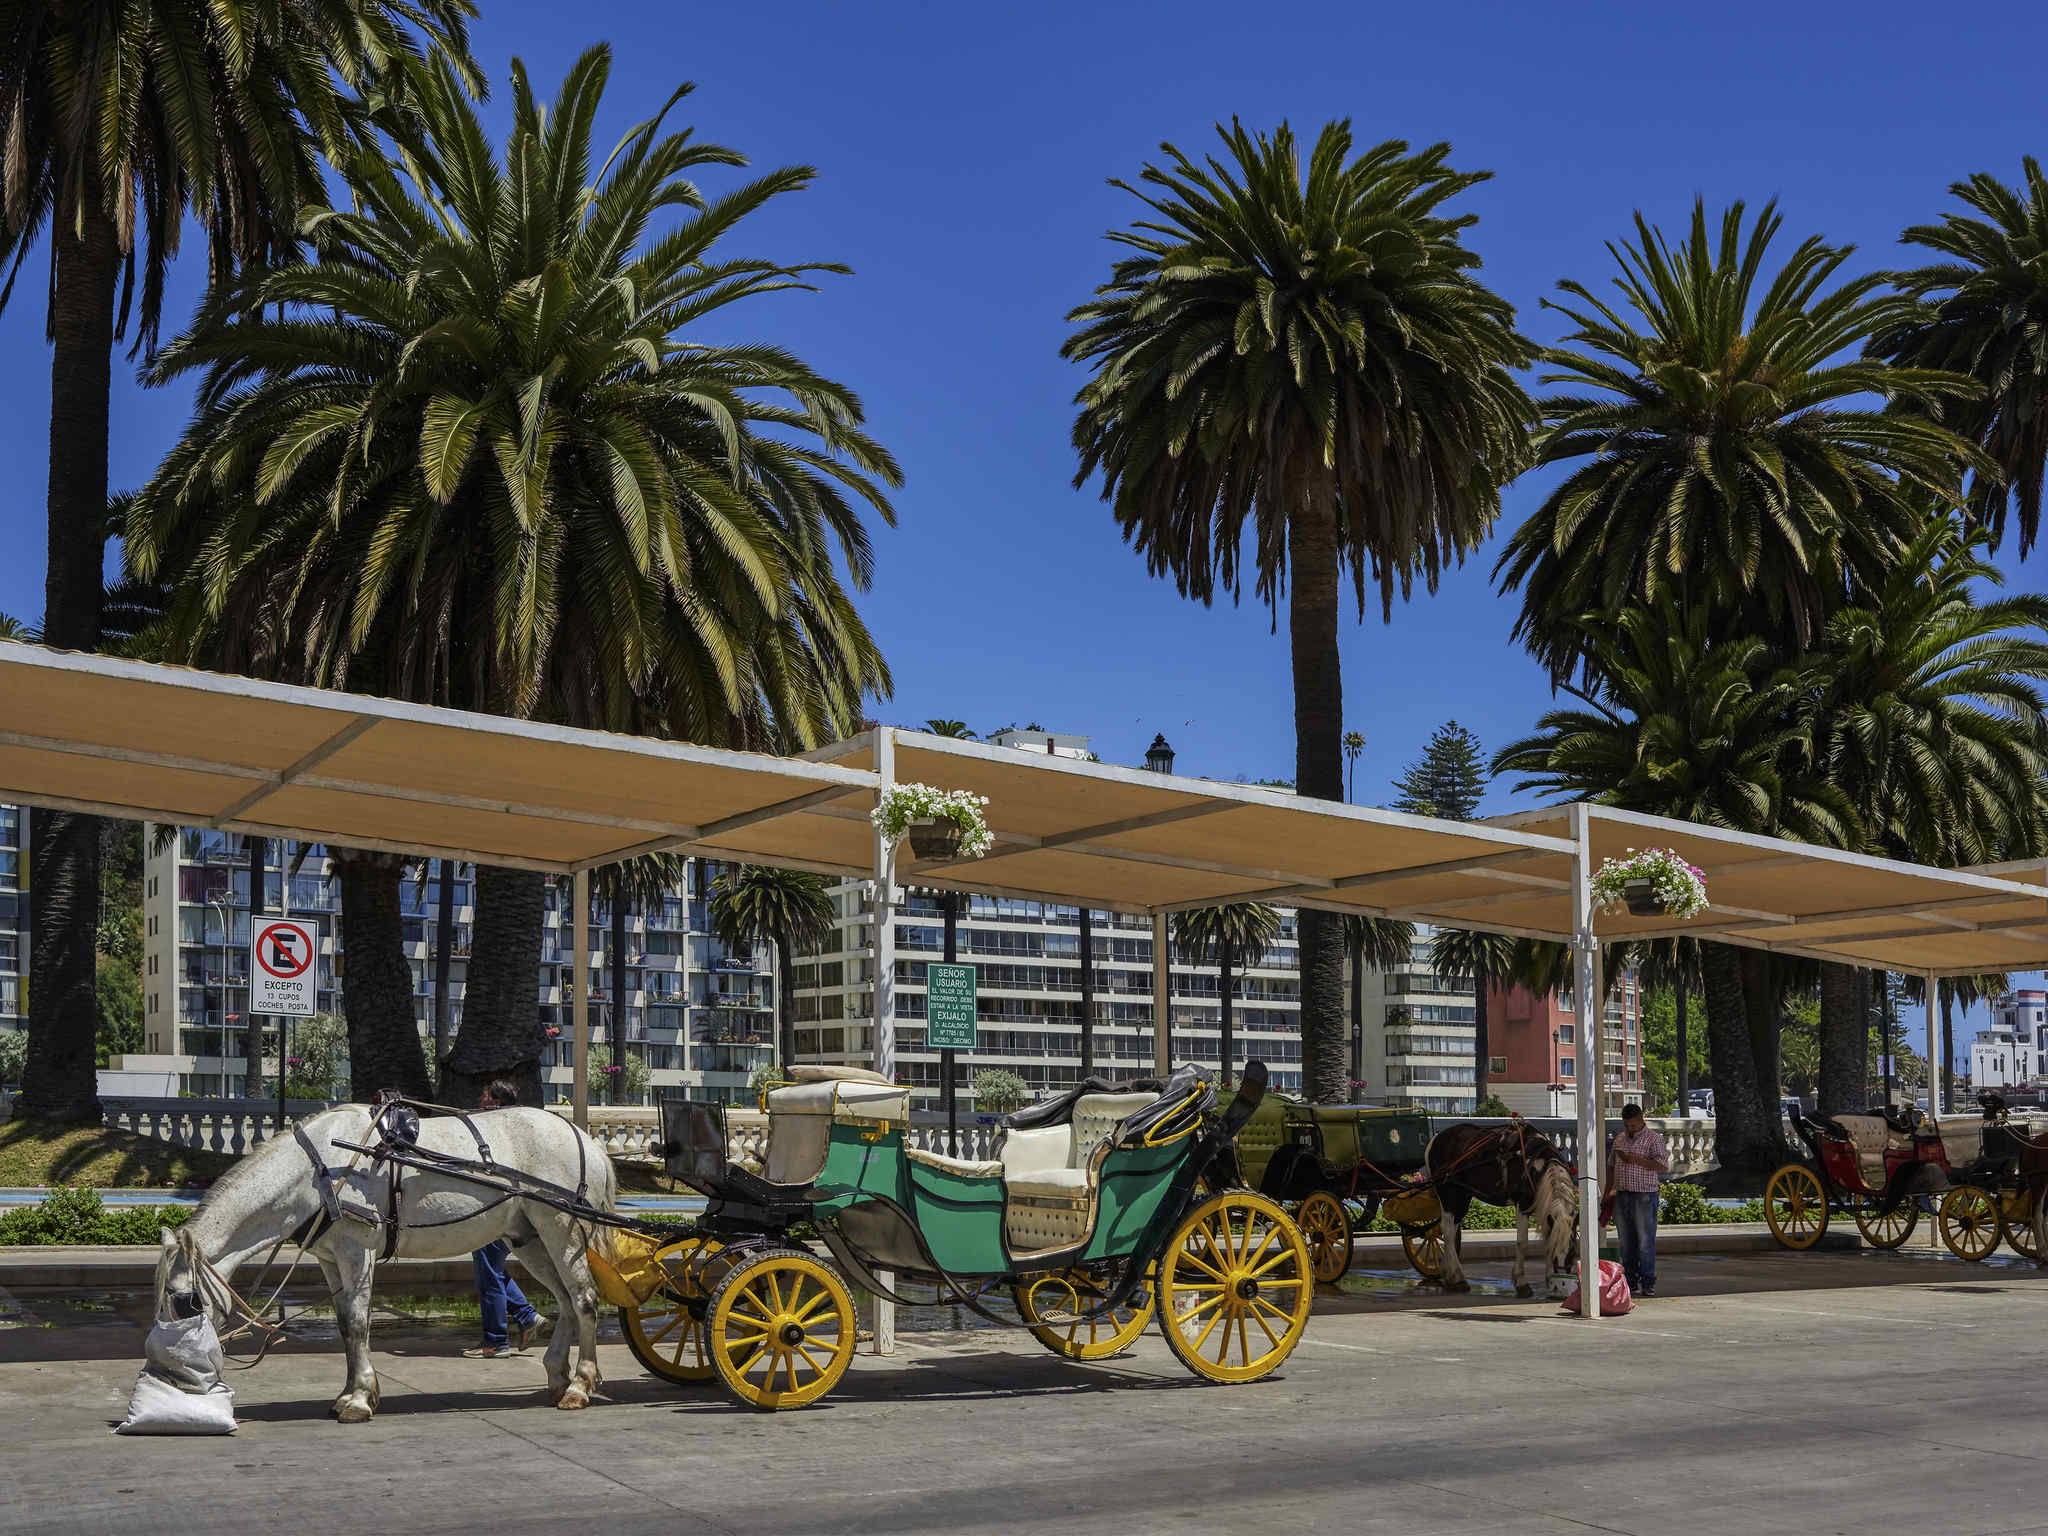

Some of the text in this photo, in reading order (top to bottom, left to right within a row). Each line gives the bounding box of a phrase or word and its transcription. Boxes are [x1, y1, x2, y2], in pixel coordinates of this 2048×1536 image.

[937, 967, 966, 979] SEÑOR
[264, 980, 303, 992] EXCEPTO
[936, 977, 968, 989] USUARIO
[940, 987, 955, 995] VALOR
[956, 988, 964, 996] DE
[278, 993, 301, 1001] CUPOS
[930, 994, 958, 1002] RECORRIDO
[257, 1000, 309, 1010] COCHES POSTA
[937, 1011, 967, 1021] EXIJALO
